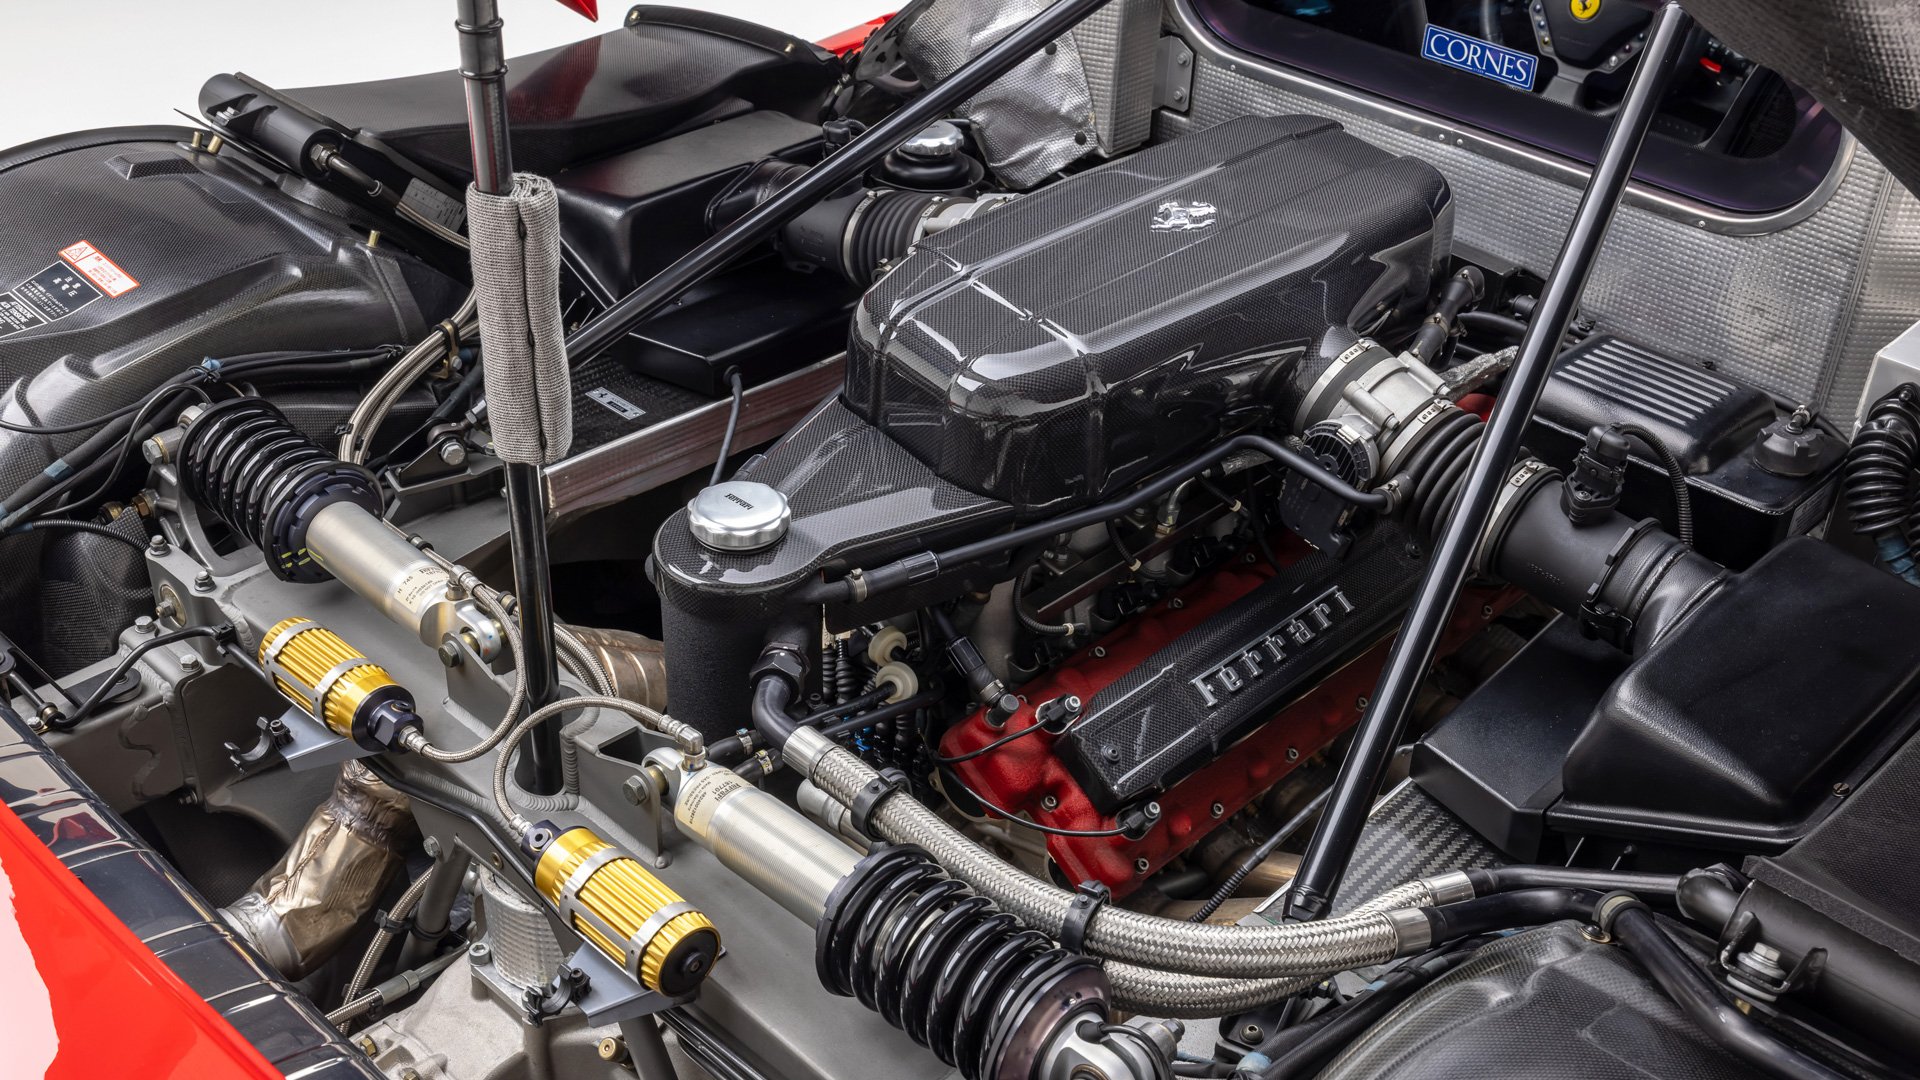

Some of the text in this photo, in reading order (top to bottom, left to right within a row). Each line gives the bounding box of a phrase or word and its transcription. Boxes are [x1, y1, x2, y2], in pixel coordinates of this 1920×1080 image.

[1430, 32, 1530, 82] CORNES
[724, 493, 755, 511] Ferrari
[1188, 585, 1356, 707] Ferrari
[714, 782, 742, 802] Ferrari
